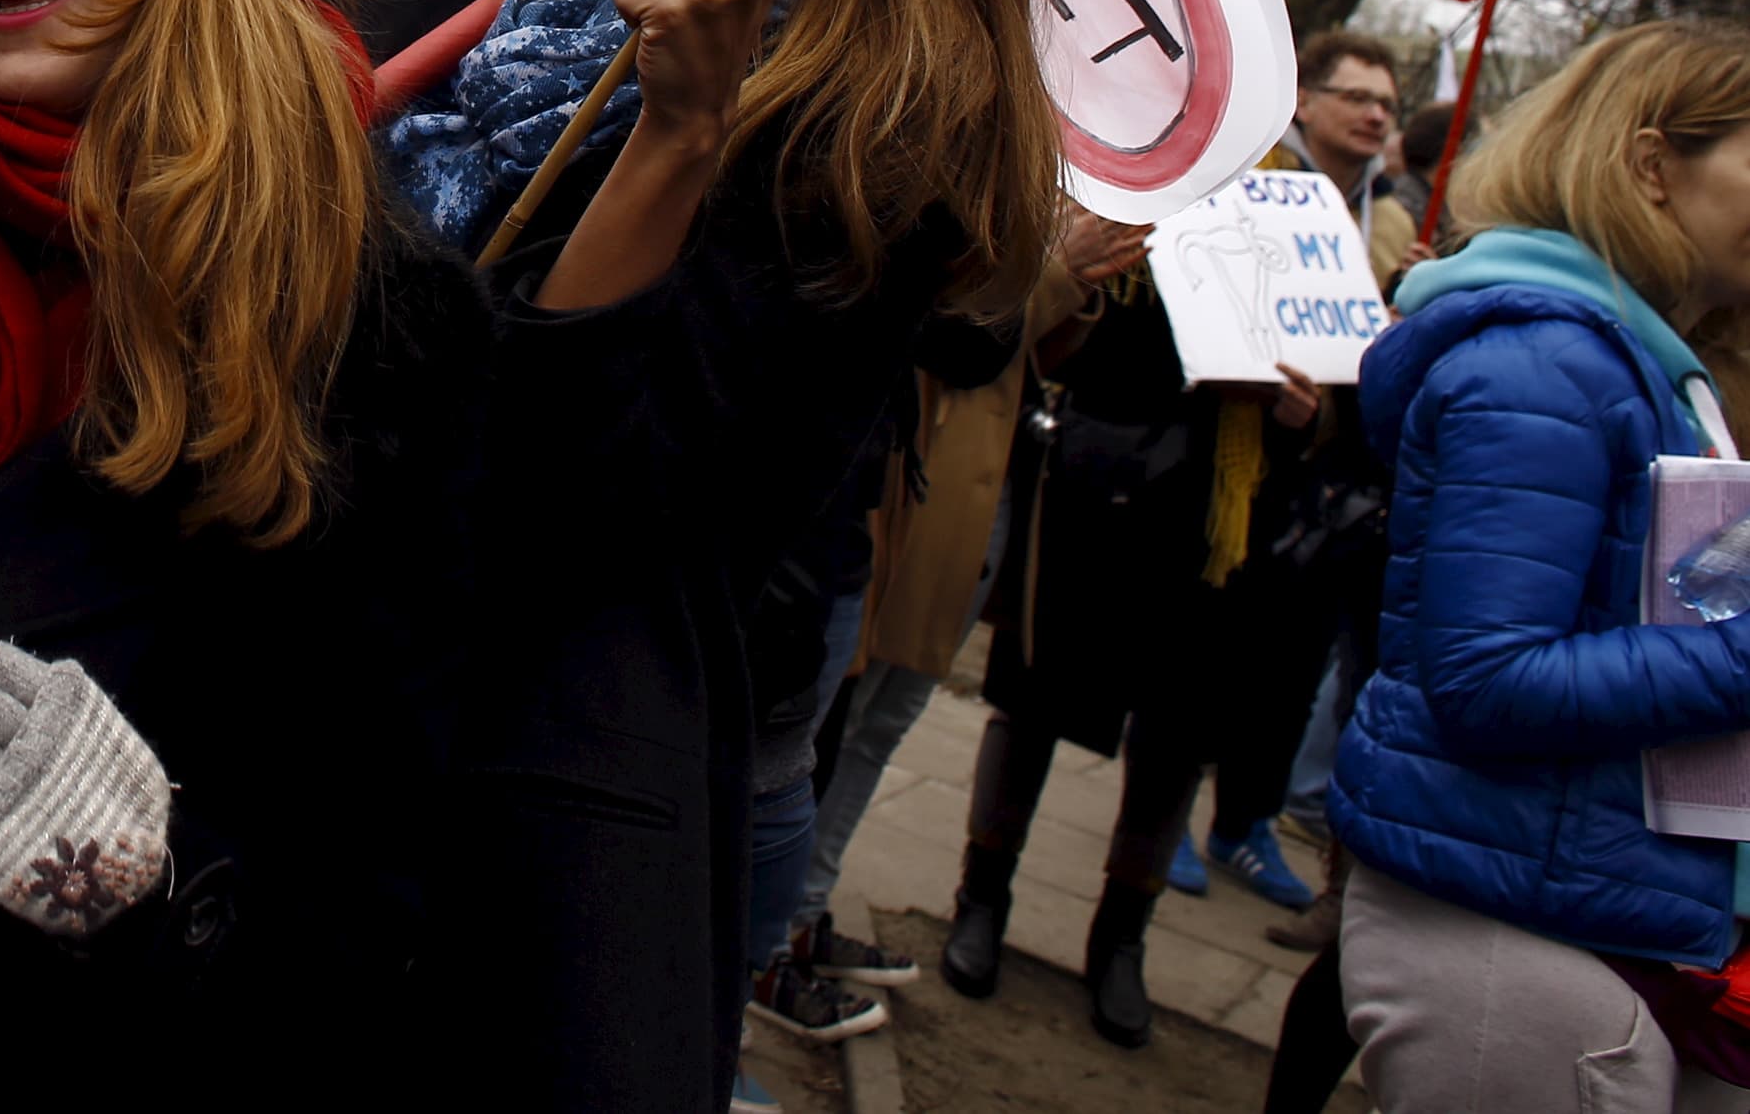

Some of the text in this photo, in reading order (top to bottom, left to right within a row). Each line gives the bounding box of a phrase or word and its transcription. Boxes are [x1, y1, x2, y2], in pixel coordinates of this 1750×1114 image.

[1240, 175, 1328, 210] BODY
[1293, 233, 1345, 272] MY
[1275, 296, 1382, 339] CHOICE
